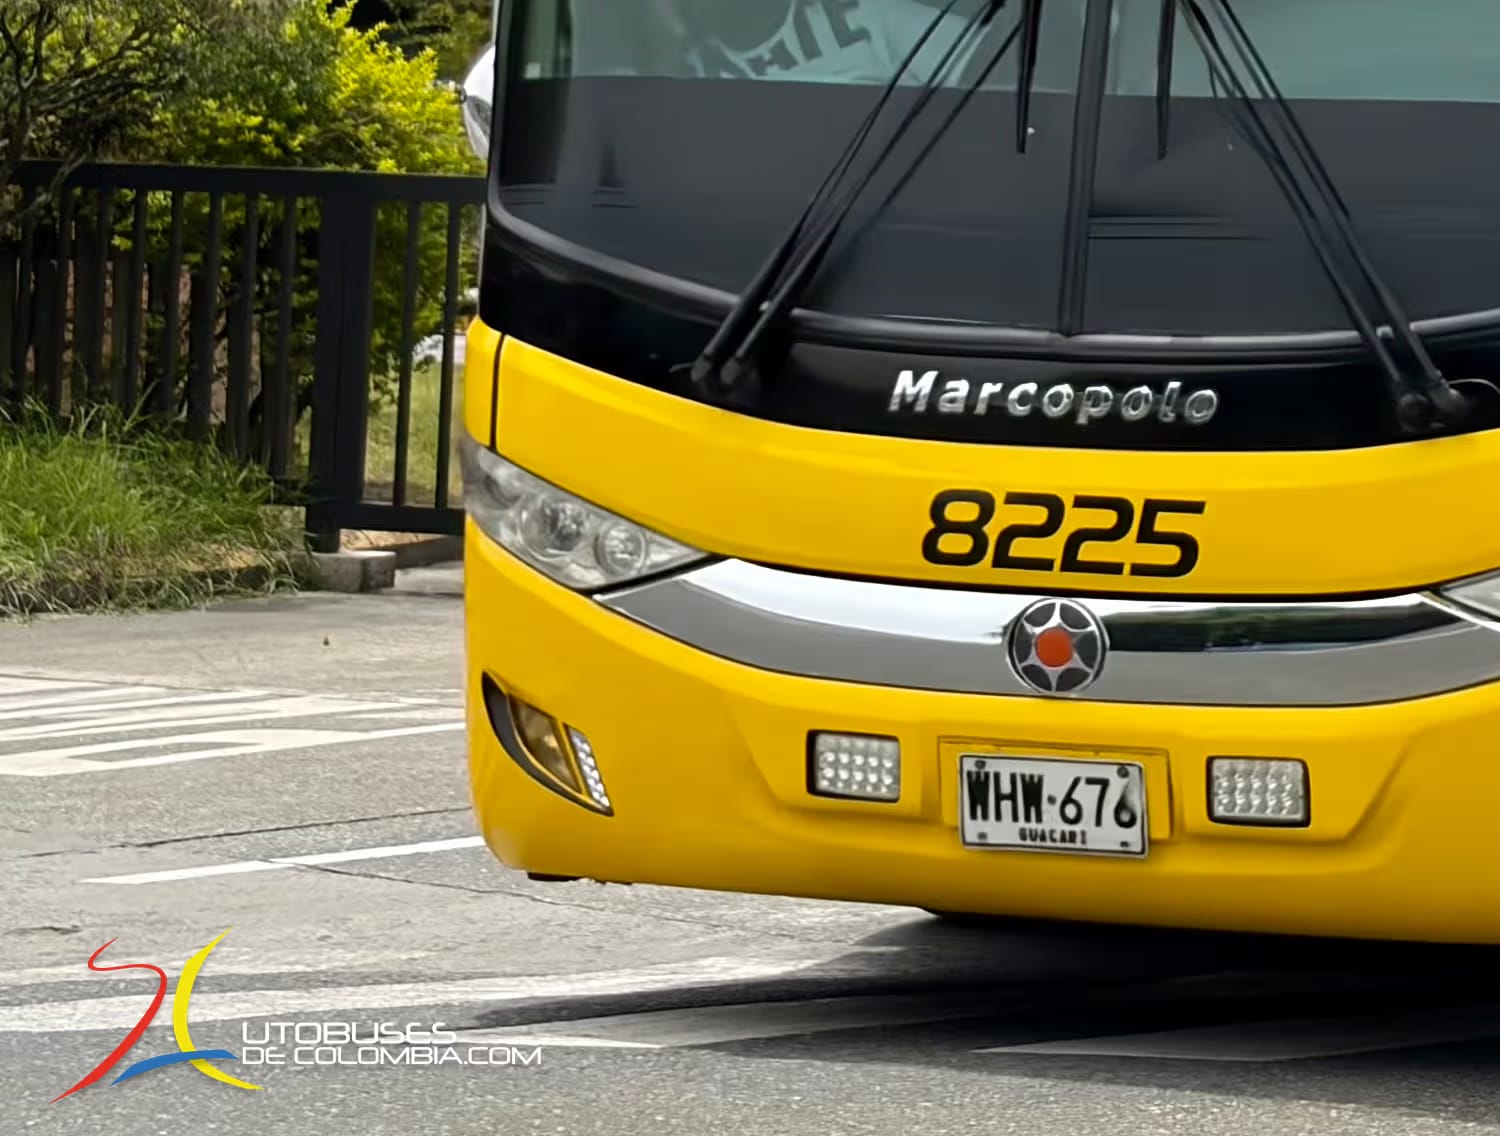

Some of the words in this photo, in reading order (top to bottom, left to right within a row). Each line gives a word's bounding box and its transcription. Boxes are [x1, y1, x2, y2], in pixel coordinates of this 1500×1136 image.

[888, 370, 1219, 424] Marcopolo
[921, 489, 1206, 578] 8225
[1018, 827, 1087, 845] GUACARI
